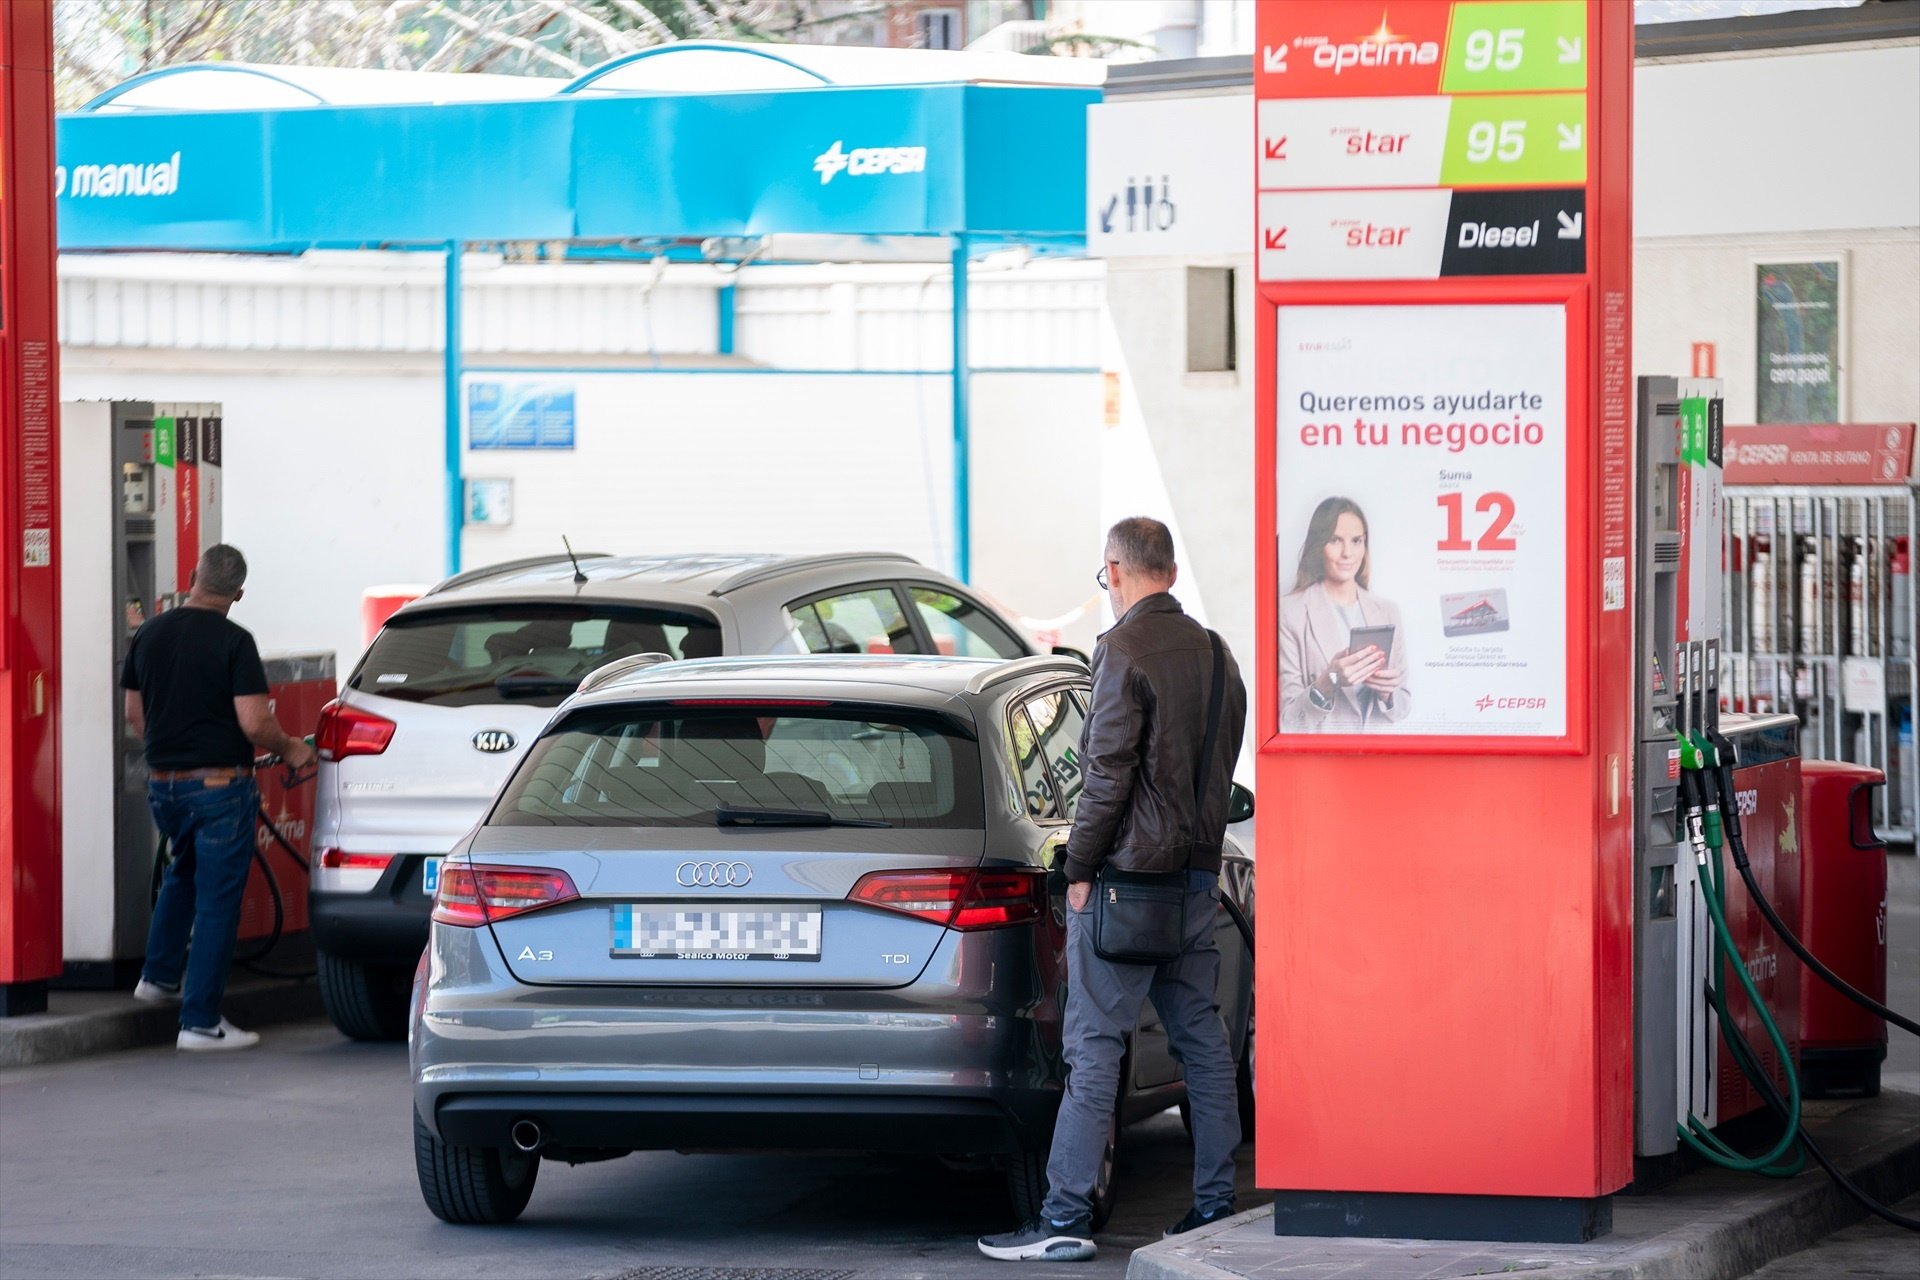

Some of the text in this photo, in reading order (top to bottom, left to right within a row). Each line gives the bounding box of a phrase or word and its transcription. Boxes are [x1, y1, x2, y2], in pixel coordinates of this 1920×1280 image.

[1313, 39, 1439, 75] optima
[1464, 28, 1525, 72] 95
[1346, 130, 1410, 155] star
[1466, 120, 1527, 163] 95
[847, 146, 927, 175] CEPSA
[71, 150, 181, 198] manual
[1346, 222, 1410, 247] star
[1458, 219, 1540, 249] Diesel
[1299, 390, 1543, 415] Queremos ayudarte
[1300, 415, 1545, 453] en tu negocio
[1739, 443, 1789, 465] CEPSA
[1439, 470, 1473, 480] Suma
[1437, 491, 1516, 551] 12
[1498, 697, 1546, 709] CEPSA
[476, 732, 510, 750] KIA
[517, 945, 553, 961] A3
[715, 952, 750, 961] Motor
[881, 954, 910, 964] TDI
